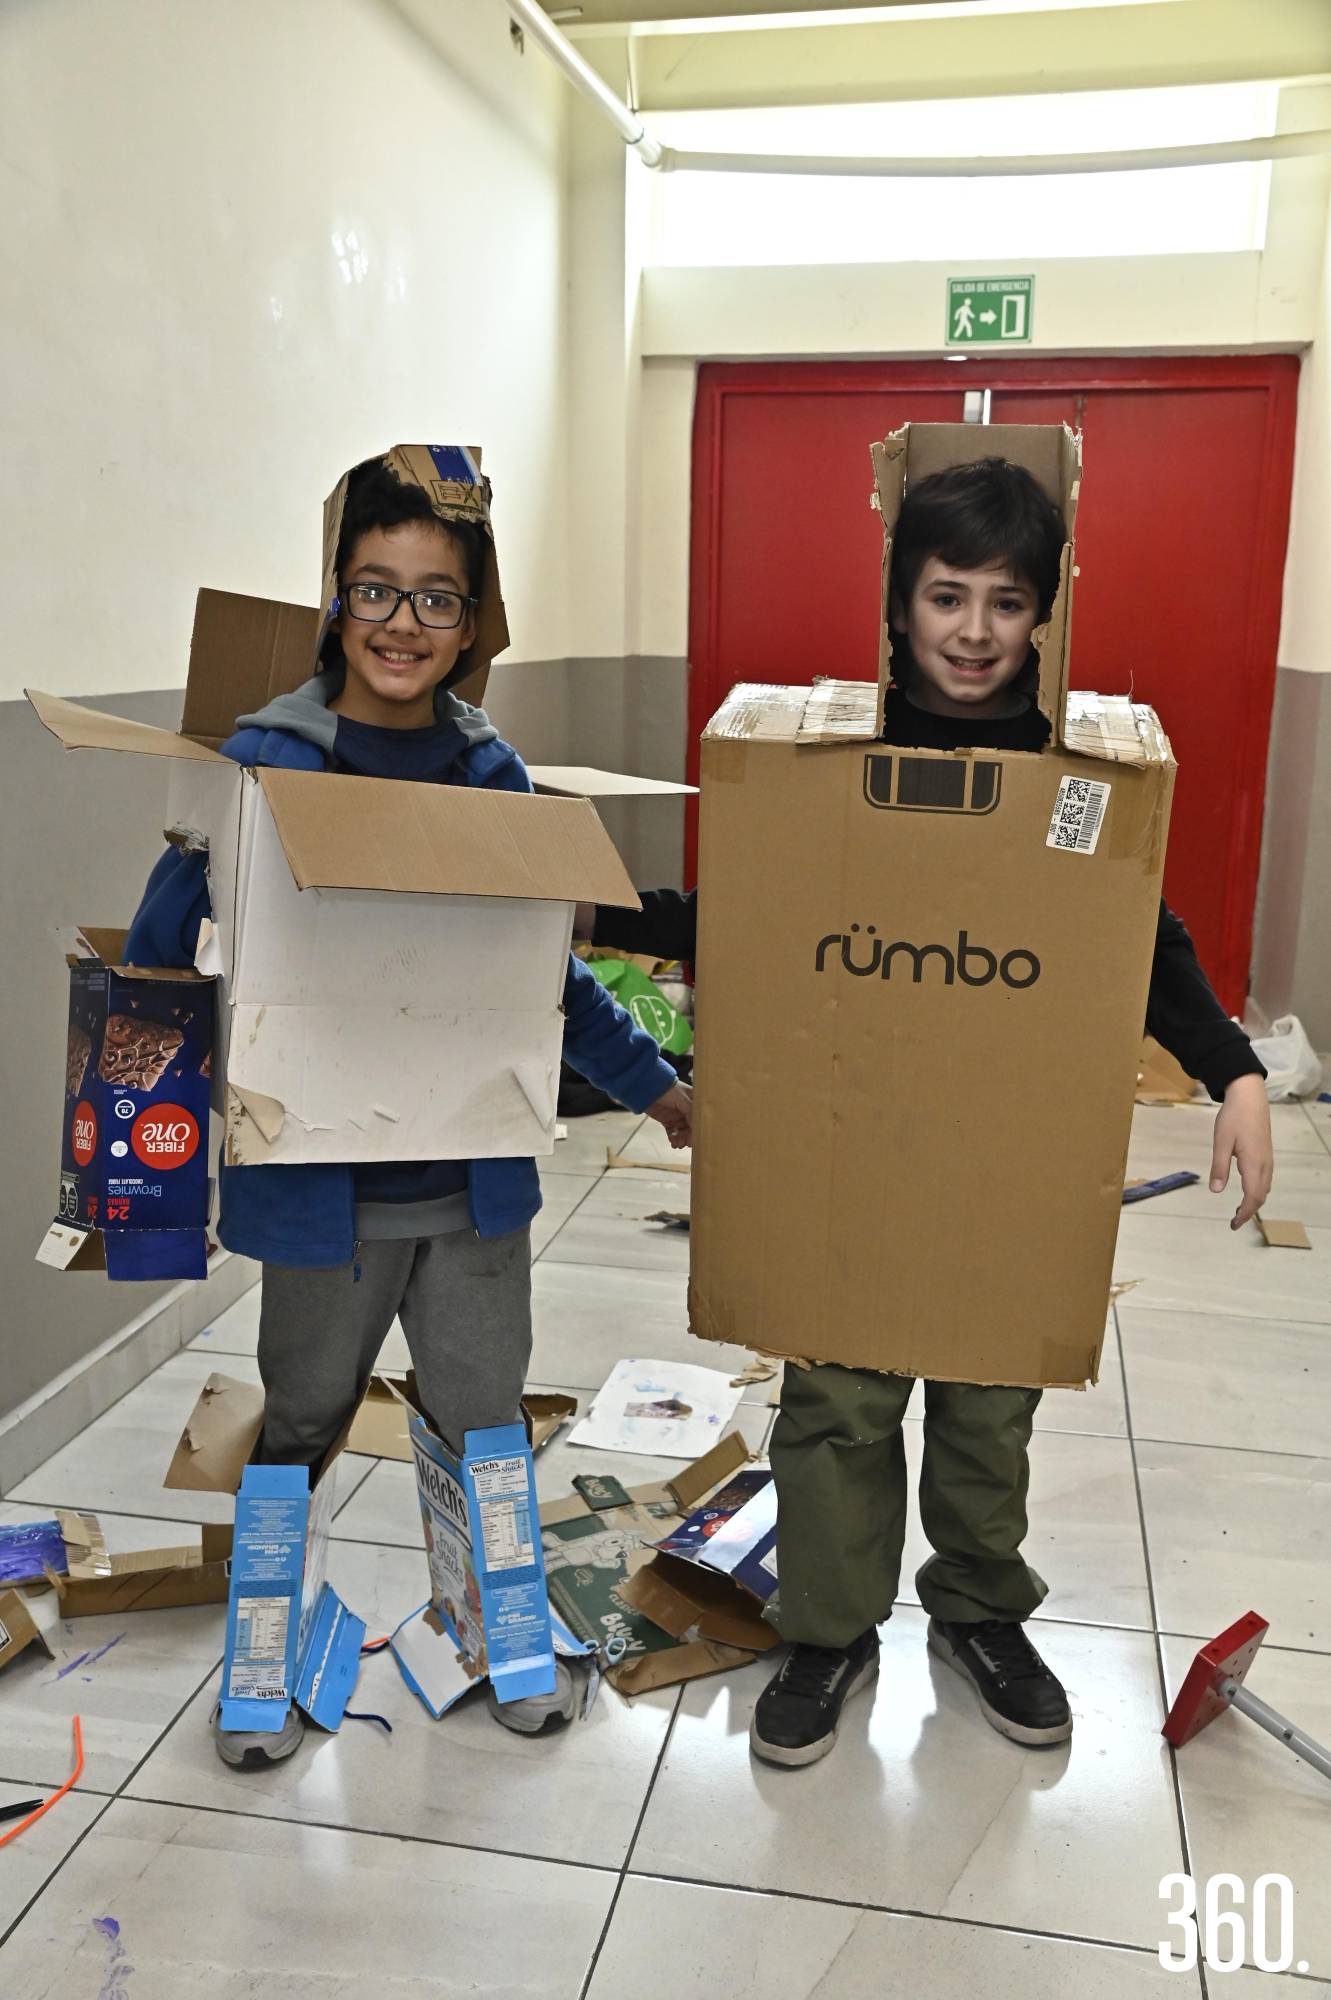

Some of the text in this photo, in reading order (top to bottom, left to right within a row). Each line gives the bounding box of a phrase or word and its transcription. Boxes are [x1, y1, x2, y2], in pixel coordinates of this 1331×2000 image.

[952, 280, 1029, 293] SALIDA DE EMERGENCIA
[815, 923, 1040, 989] rümbo
[76, 1138, 92, 1150] FIBER
[146, 1142, 185, 1153] FIBER
[108, 1185, 162, 1197] Brownies
[107, 1205, 130, 1220] 24
[471, 1462, 499, 1474] Welch's
[414, 1450, 468, 1528] Welch's
